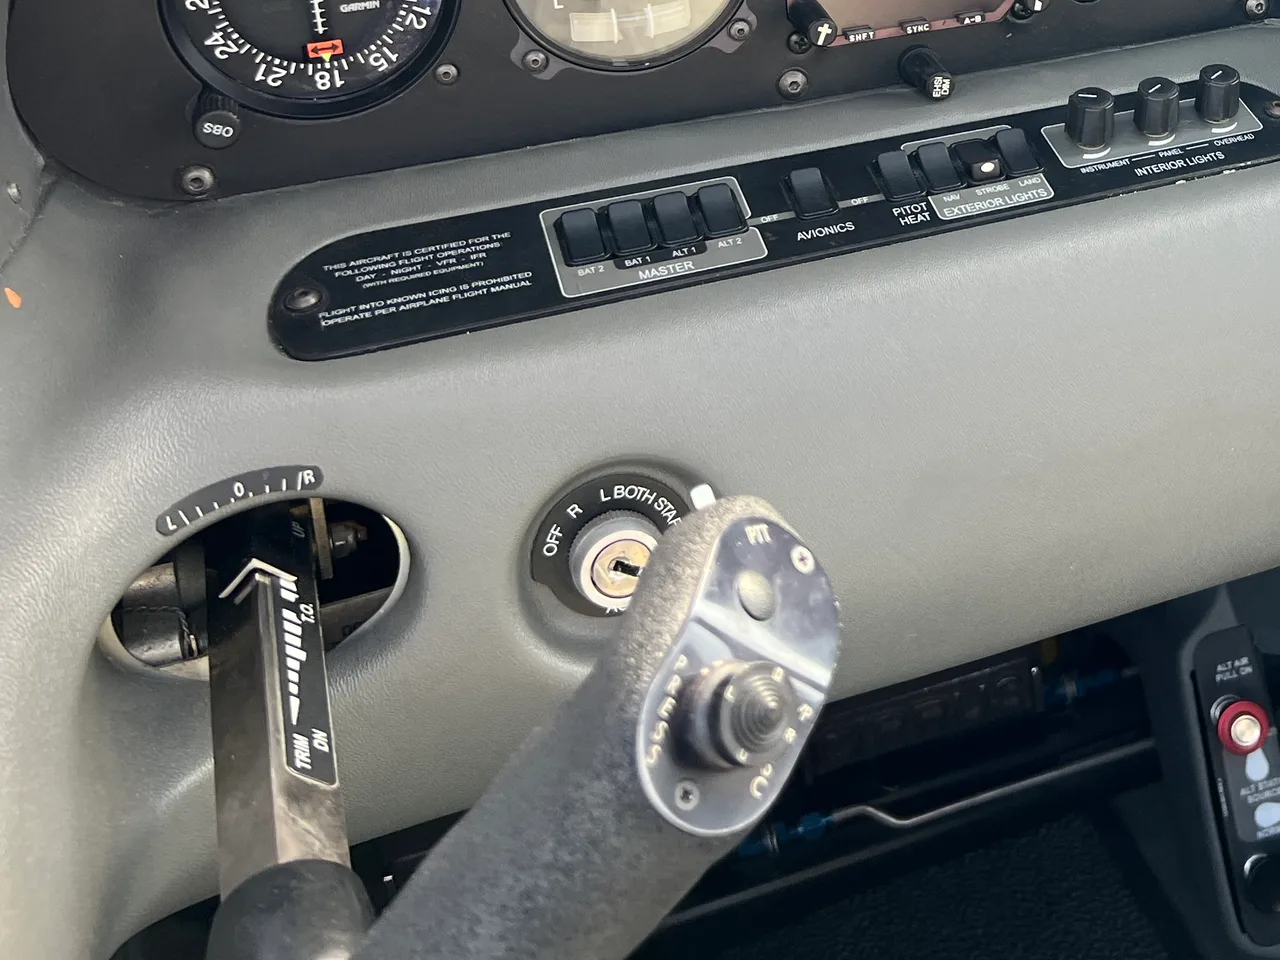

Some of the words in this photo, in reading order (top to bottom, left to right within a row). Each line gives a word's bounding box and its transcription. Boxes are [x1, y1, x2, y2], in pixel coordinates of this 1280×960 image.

[340, 0, 380, 13] GARMIN
[906, 21, 931, 33] SYNC
[1213, 133, 1255, 147] OVERHEAD
[1159, 148, 1184, 159] PANEL
[1080, 158, 1131, 174] INSTRUMENT
[1134, 159, 1187, 177] INTERIOR
[1186, 151, 1225, 167] LIGHTS
[975, 183, 1010, 197] STROBE
[1018, 176, 1042, 188] LAND
[891, 201, 928, 217] PITOT
[943, 197, 1004, 218] EXTERIOR
[1005, 188, 1048, 205] LIGHTS
[899, 211, 932, 226] HEAT
[796, 221, 856, 242] AVIONICS
[718, 239, 736, 249] ALT
[736, 237, 744, 246] 2
[625, 257, 644, 268] BAT
[646, 255, 651, 263] 1
[638, 261, 695, 281] MASTER
[318, 306, 357, 319] FLIGHT
[359, 300, 385, 311] INTO
[386, 292, 428, 305] KNOWN
[429, 286, 458, 297] ICING
[459, 283, 470, 291] IS
[471, 271, 533, 288] PROHIBITED
[321, 311, 373, 327] OPERATE
[374, 307, 398, 317] PER
[399, 295, 451, 312] AIRPLANE
[452, 287, 489, 301] FLIGHT
[490, 280, 533, 293] MANUAL
[614, 484, 656, 505] BOTH
[543, 523, 563, 557] OFF
[745, 523, 772, 545] PTT
[312, 728, 330, 753] DN
[293, 732, 312, 771] TRIM
